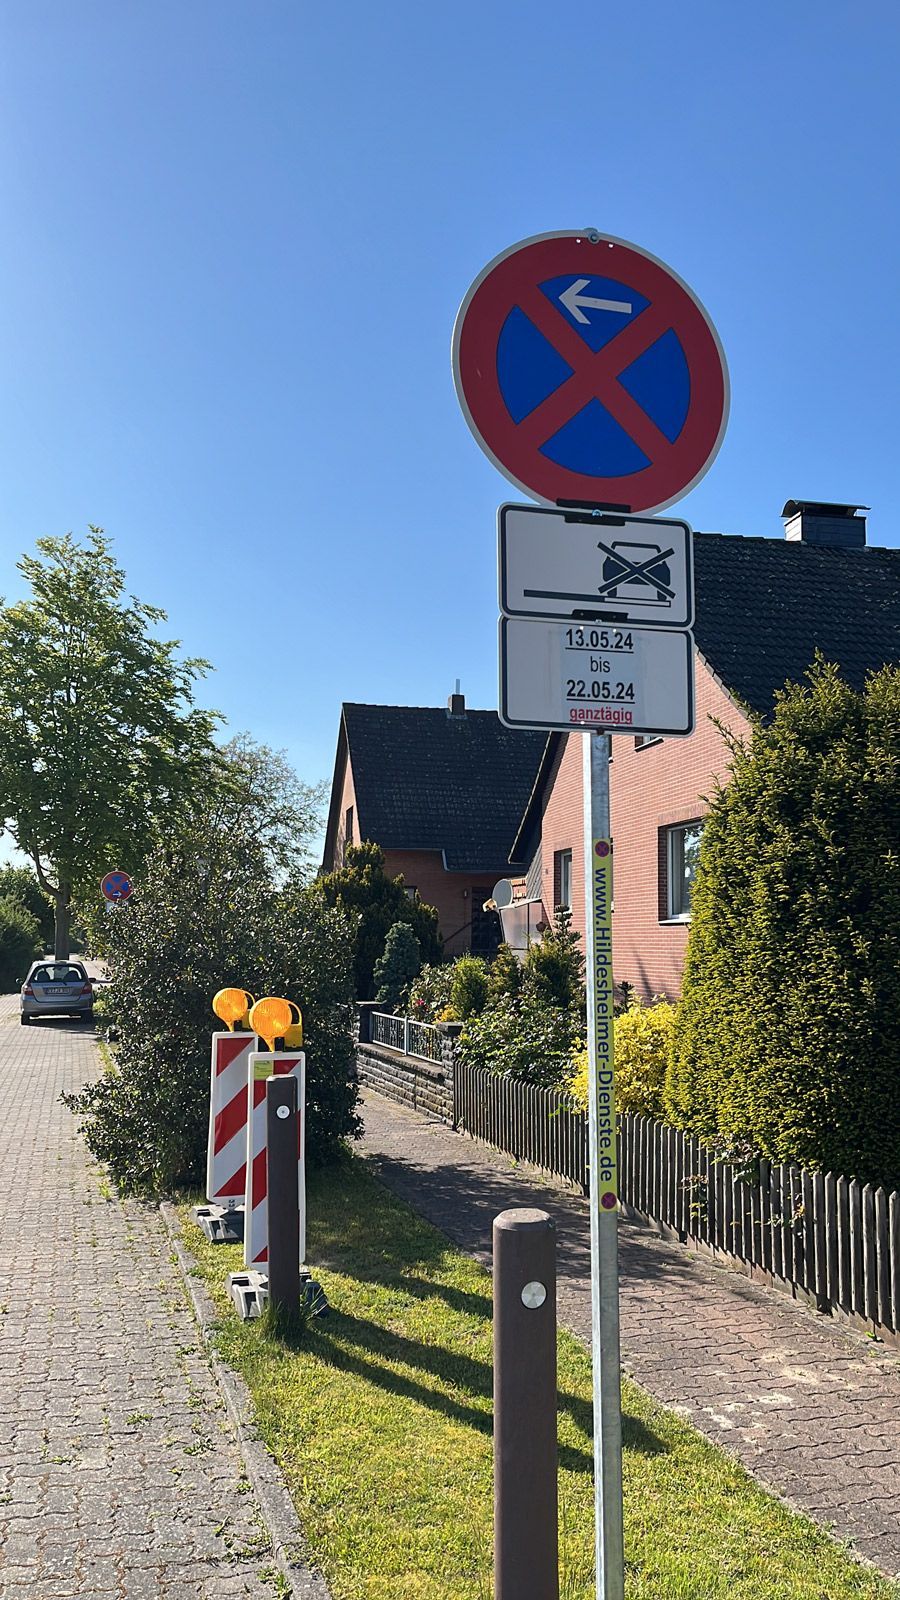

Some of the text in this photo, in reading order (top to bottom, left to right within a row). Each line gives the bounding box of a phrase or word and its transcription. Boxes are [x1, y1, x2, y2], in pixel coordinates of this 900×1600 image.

[566, 629, 634, 650] 13.05.24
[590, 656, 611, 673] bis
[566, 680, 635, 700] 22.05.24
[569, 706, 633, 725] ganztägig
[594, 867, 616, 1182] www.Hildesheimer-Dienste.de
